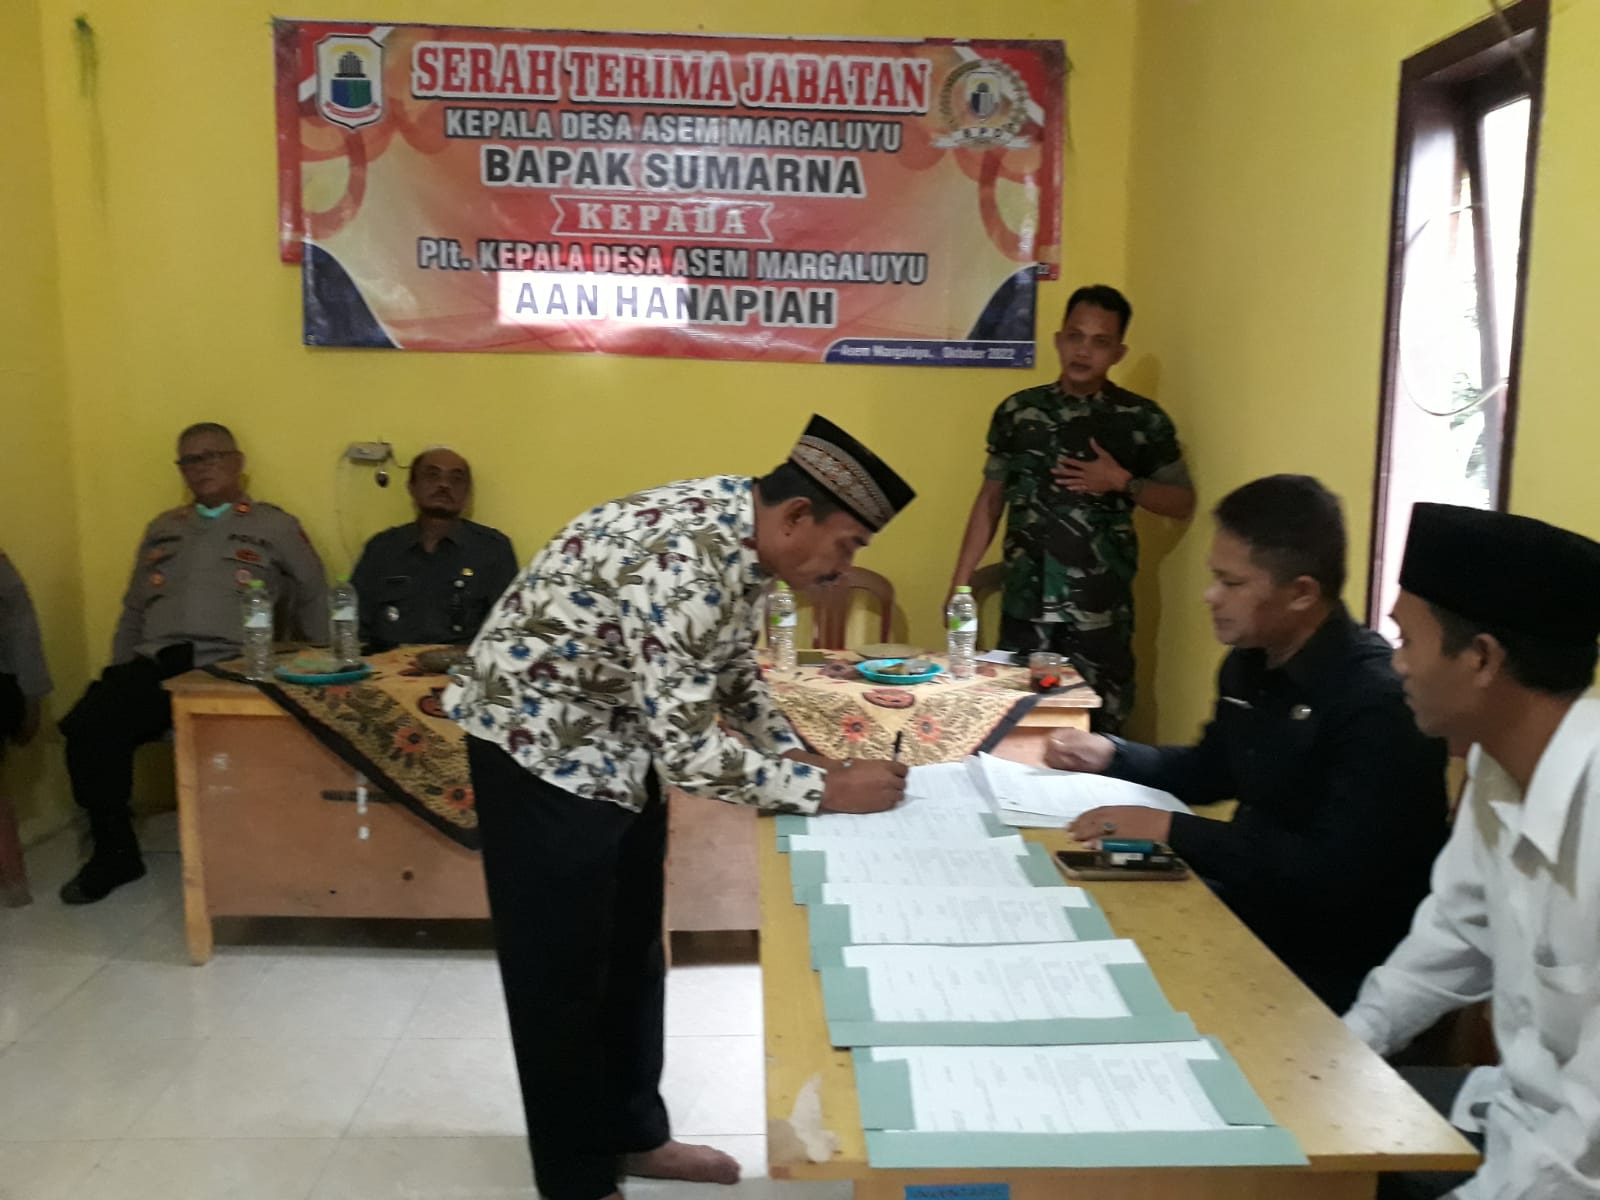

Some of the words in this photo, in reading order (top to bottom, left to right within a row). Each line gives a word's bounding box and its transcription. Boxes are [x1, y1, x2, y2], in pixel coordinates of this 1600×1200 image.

[415, 45, 559, 97] SERAH
[570, 50, 735, 104] TERIMA
[743, 57, 930, 111] JABATAN
[446, 109, 552, 138] KEPALA
[561, 112, 632, 140] DESA
[641, 115, 719, 144] ASEM
[727, 118, 901, 151] MARGALUYU
[484, 147, 634, 187] BAPAK
[645, 152, 862, 196] SUMARNA
[578, 203, 747, 236] KEPADA
[418, 238, 471, 268] Plt.
[479, 241, 582, 272] KEPALA
[593, 243, 663, 275] DESA
[672, 248, 749, 278] ASEM
[757, 252, 927, 283] MARGALUYU
[515, 282, 598, 316] AAN
[616, 285, 833, 324] HANAPIAH
